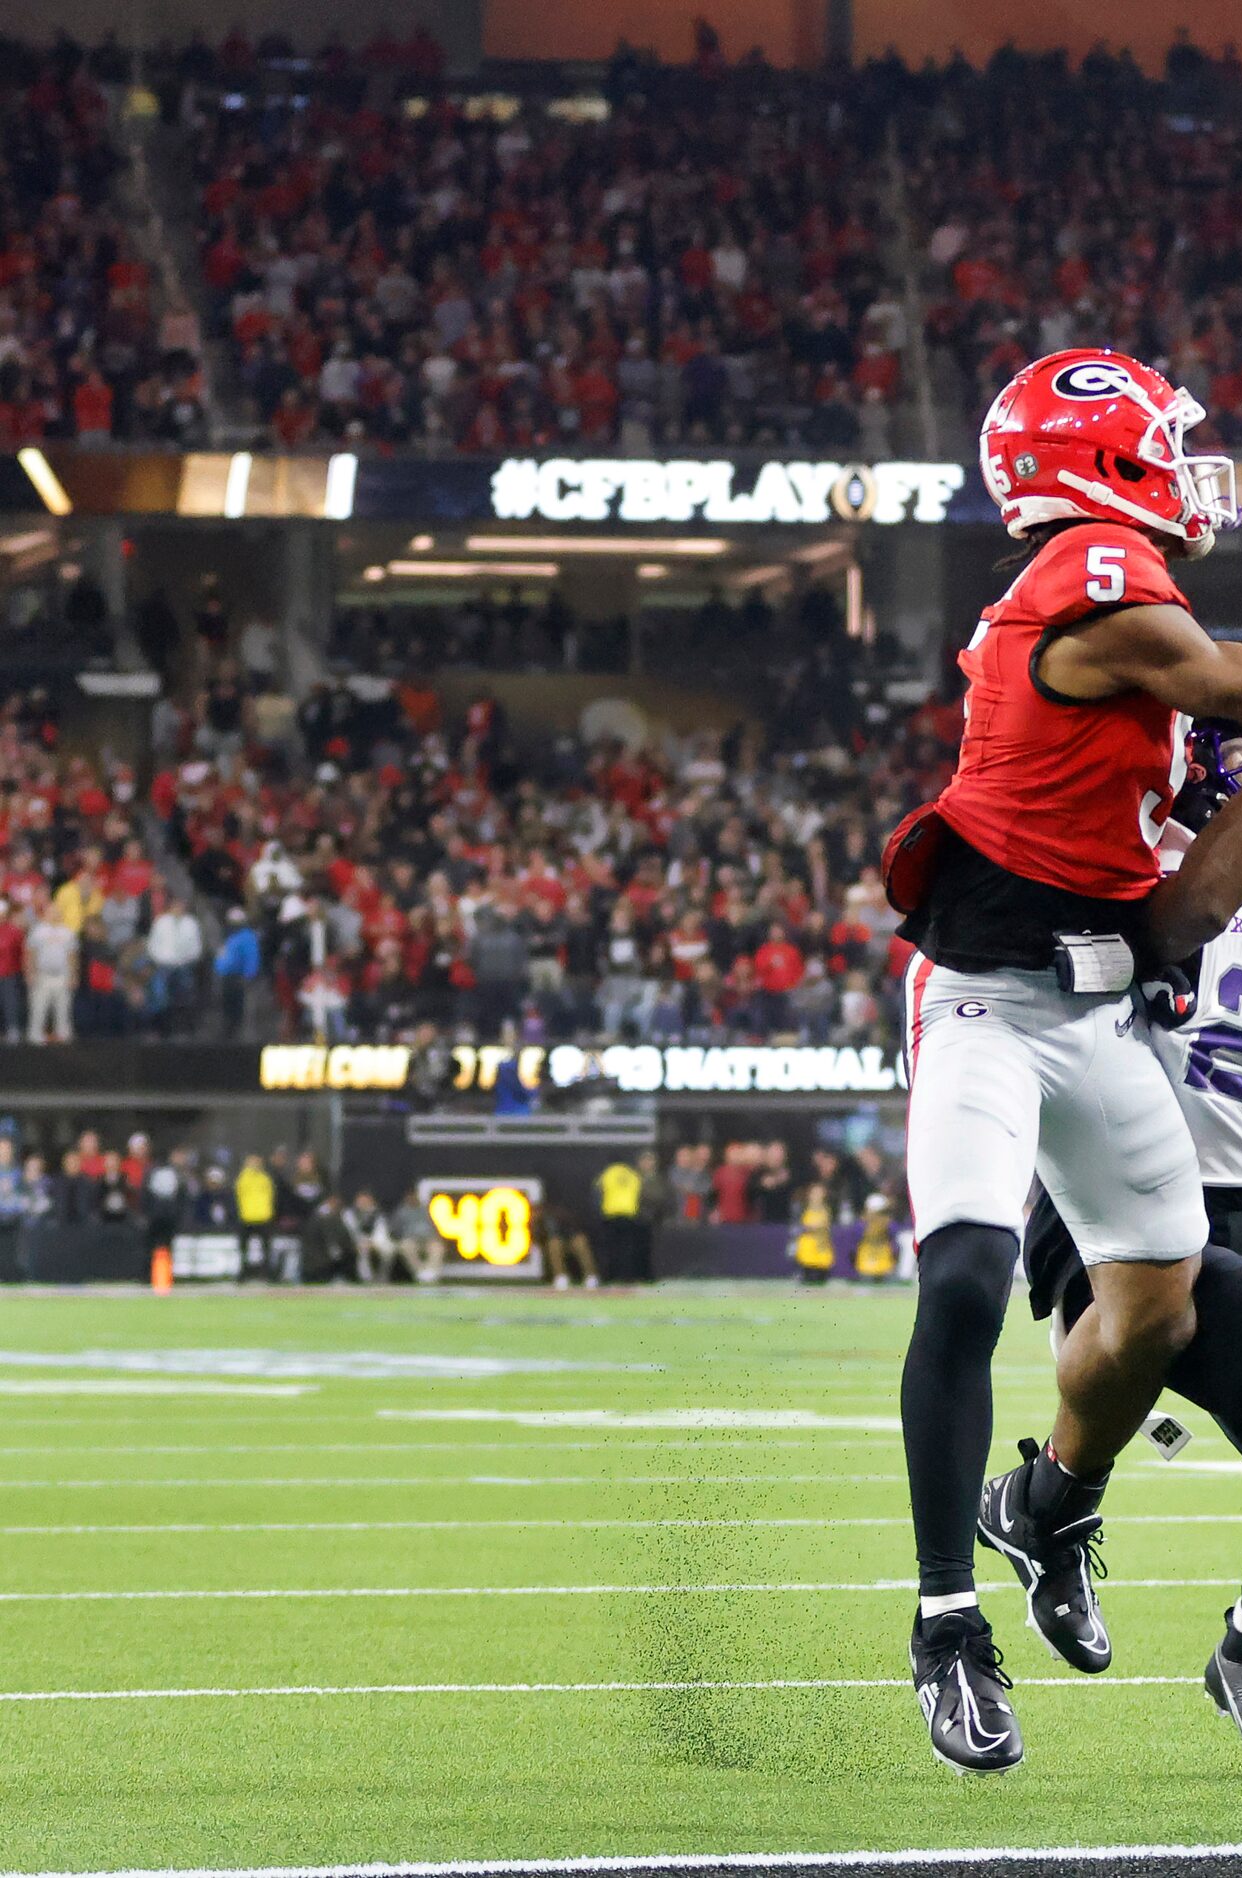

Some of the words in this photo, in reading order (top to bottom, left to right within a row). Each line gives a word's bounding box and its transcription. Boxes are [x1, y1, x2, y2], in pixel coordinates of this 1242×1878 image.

[1085, 545, 1127, 602] 5
[955, 1001, 988, 1018] G
[664, 1046, 896, 1091] NATIONAL
[429, 1187, 532, 1267] 40
